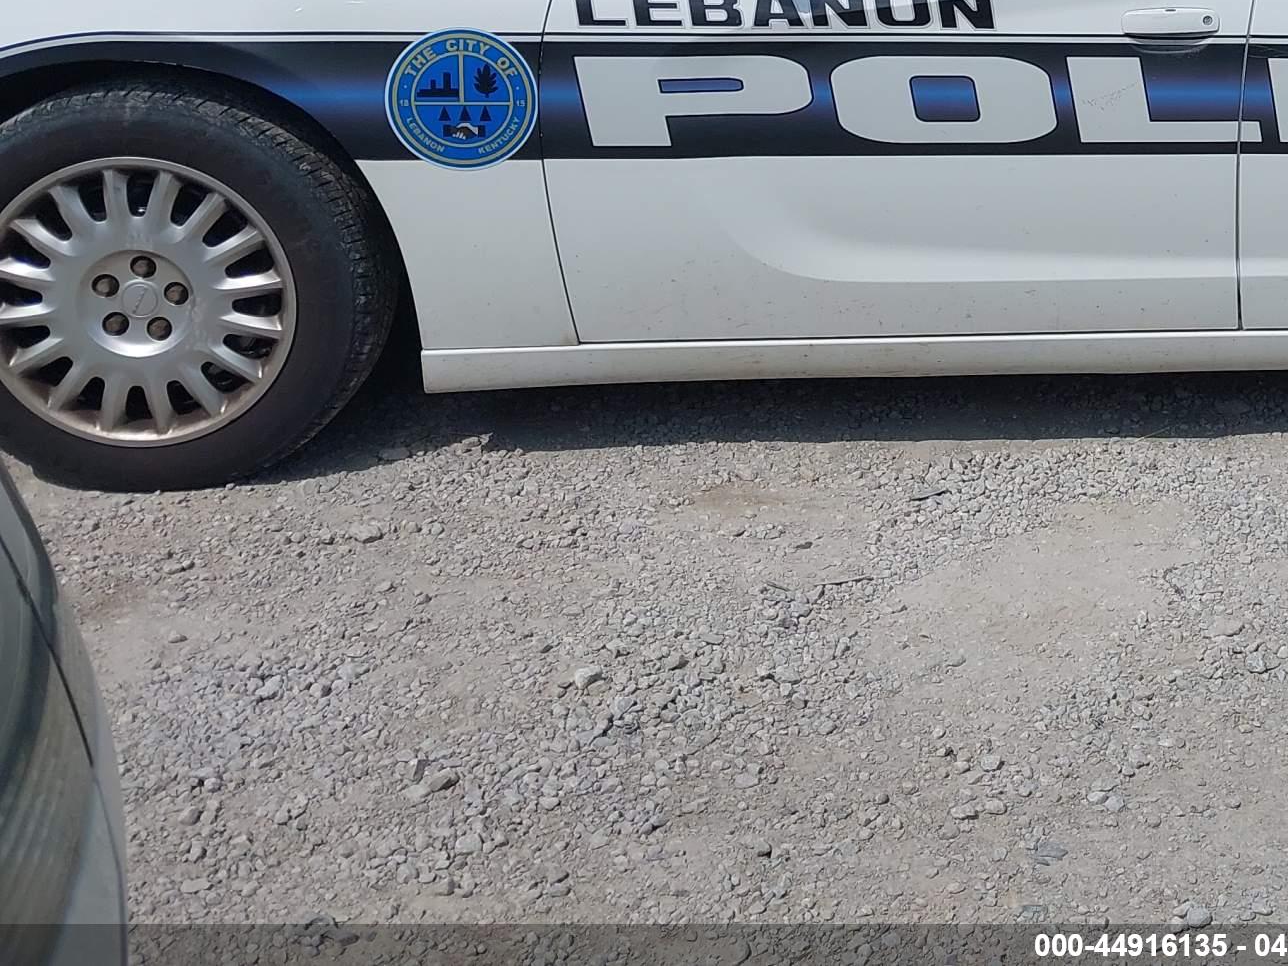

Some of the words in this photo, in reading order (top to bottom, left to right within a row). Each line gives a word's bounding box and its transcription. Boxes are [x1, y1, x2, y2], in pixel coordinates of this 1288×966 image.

[404, 46, 437, 78] THE
[445, 39, 491, 56] CITY
[496, 56, 518, 78] OF
[406, 117, 445, 153] LEBANON
[478, 117, 521, 154] KENTUCKY
